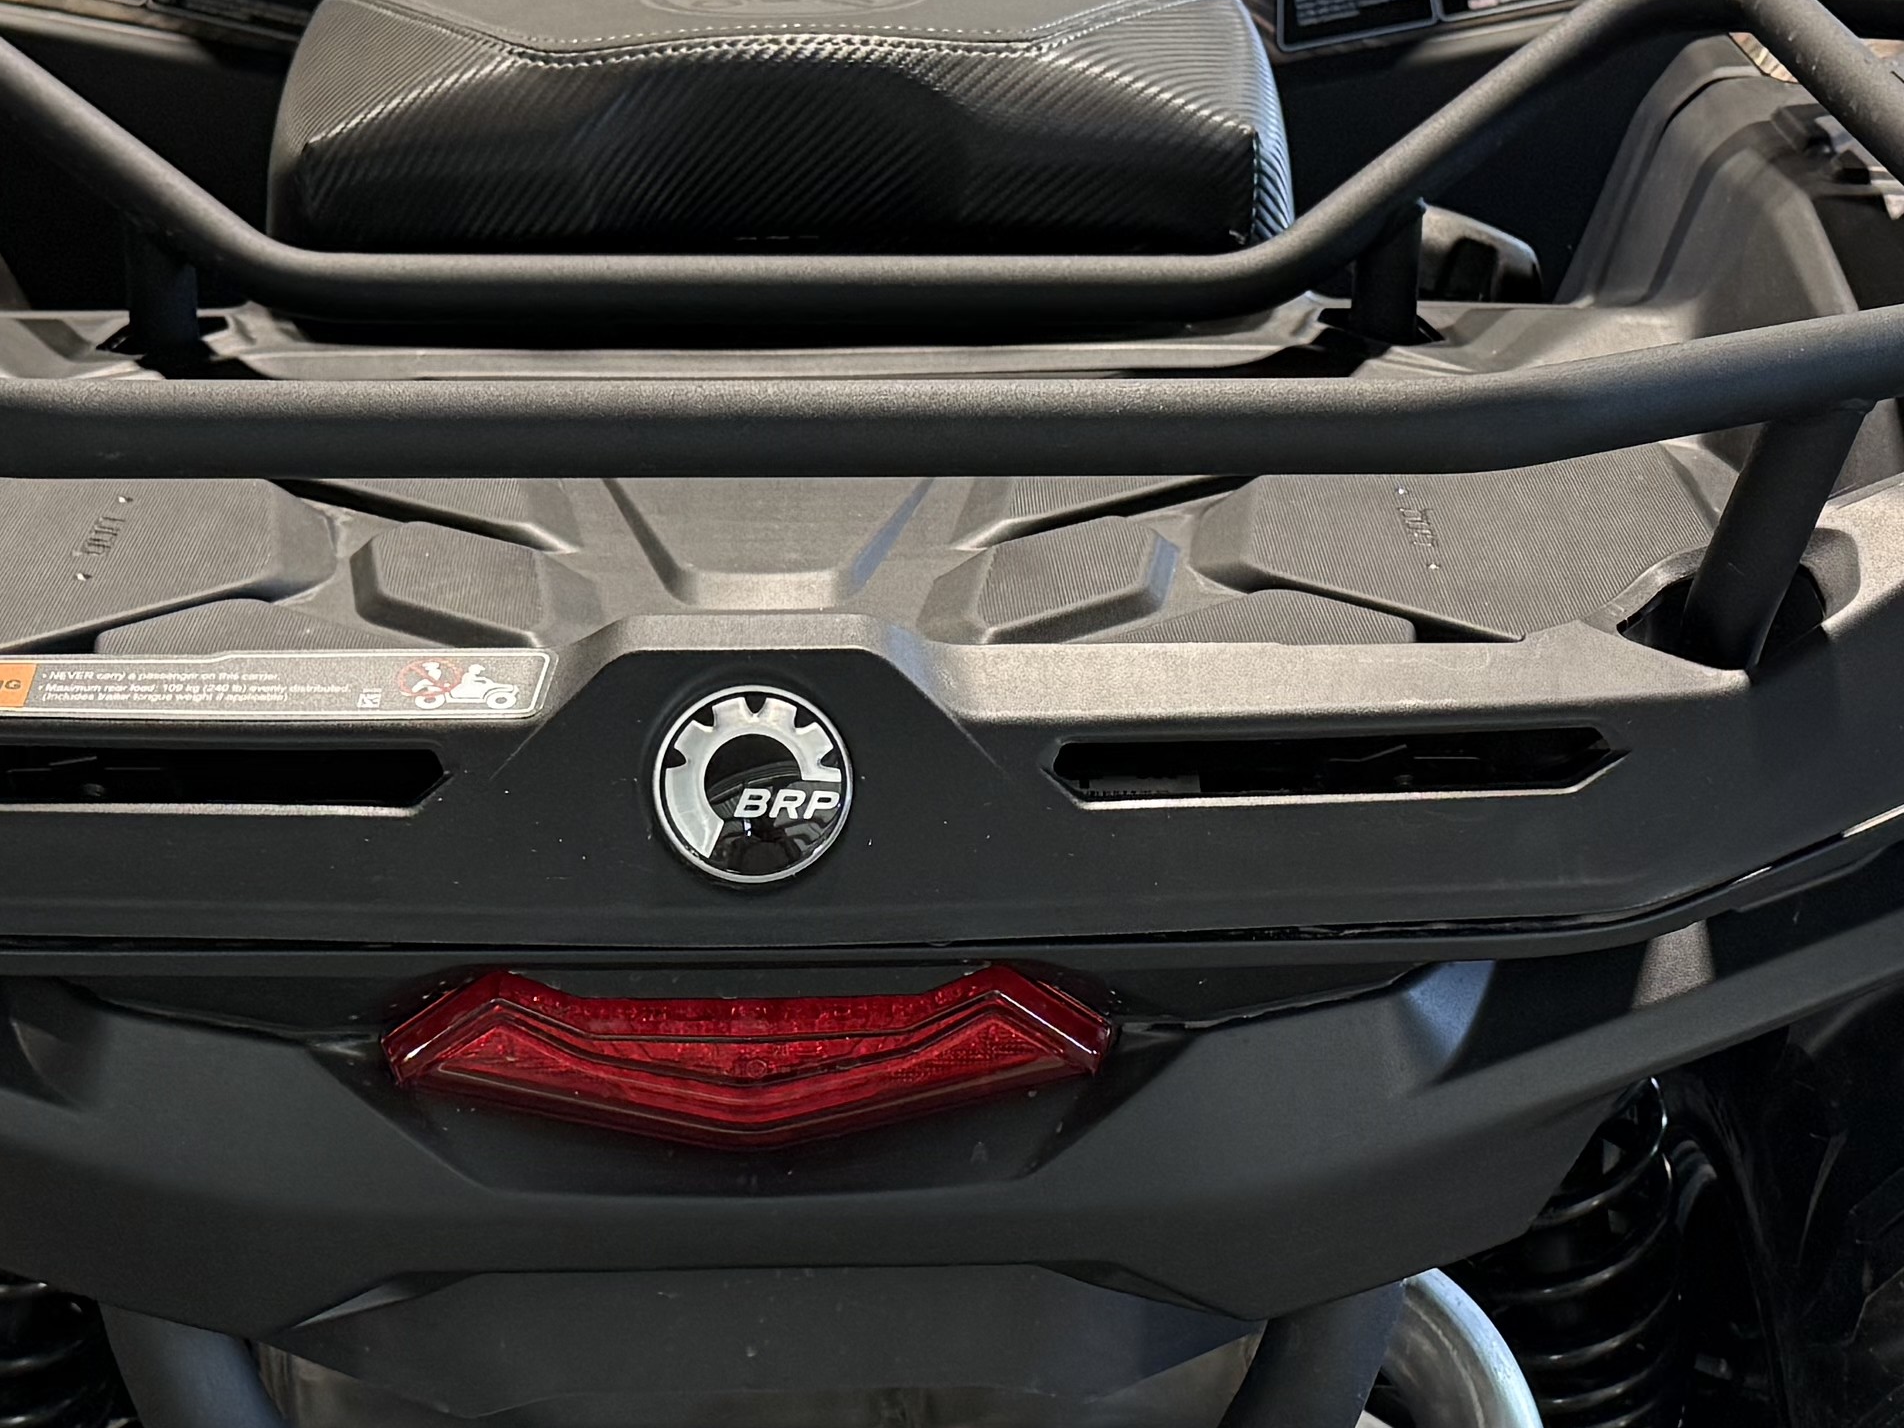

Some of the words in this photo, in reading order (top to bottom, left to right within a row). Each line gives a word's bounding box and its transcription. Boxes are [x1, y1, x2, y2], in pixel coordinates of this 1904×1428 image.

[49, 671, 94, 680] NEVER
[97, 671, 126, 681] carry
[138, 672, 199, 681] passenger
[218, 672, 239, 680] this
[46, 684, 101, 692] Maximum
[163, 684, 183, 692] 109
[185, 684, 200, 694] kg
[203, 684, 229, 693] (240
[232, 684, 246, 693] lb)
[249, 685, 287, 694] evenly
[133, 694, 172, 702] tongue
[176, 693, 212, 702] weight
[734, 788, 840, 819] BRP
